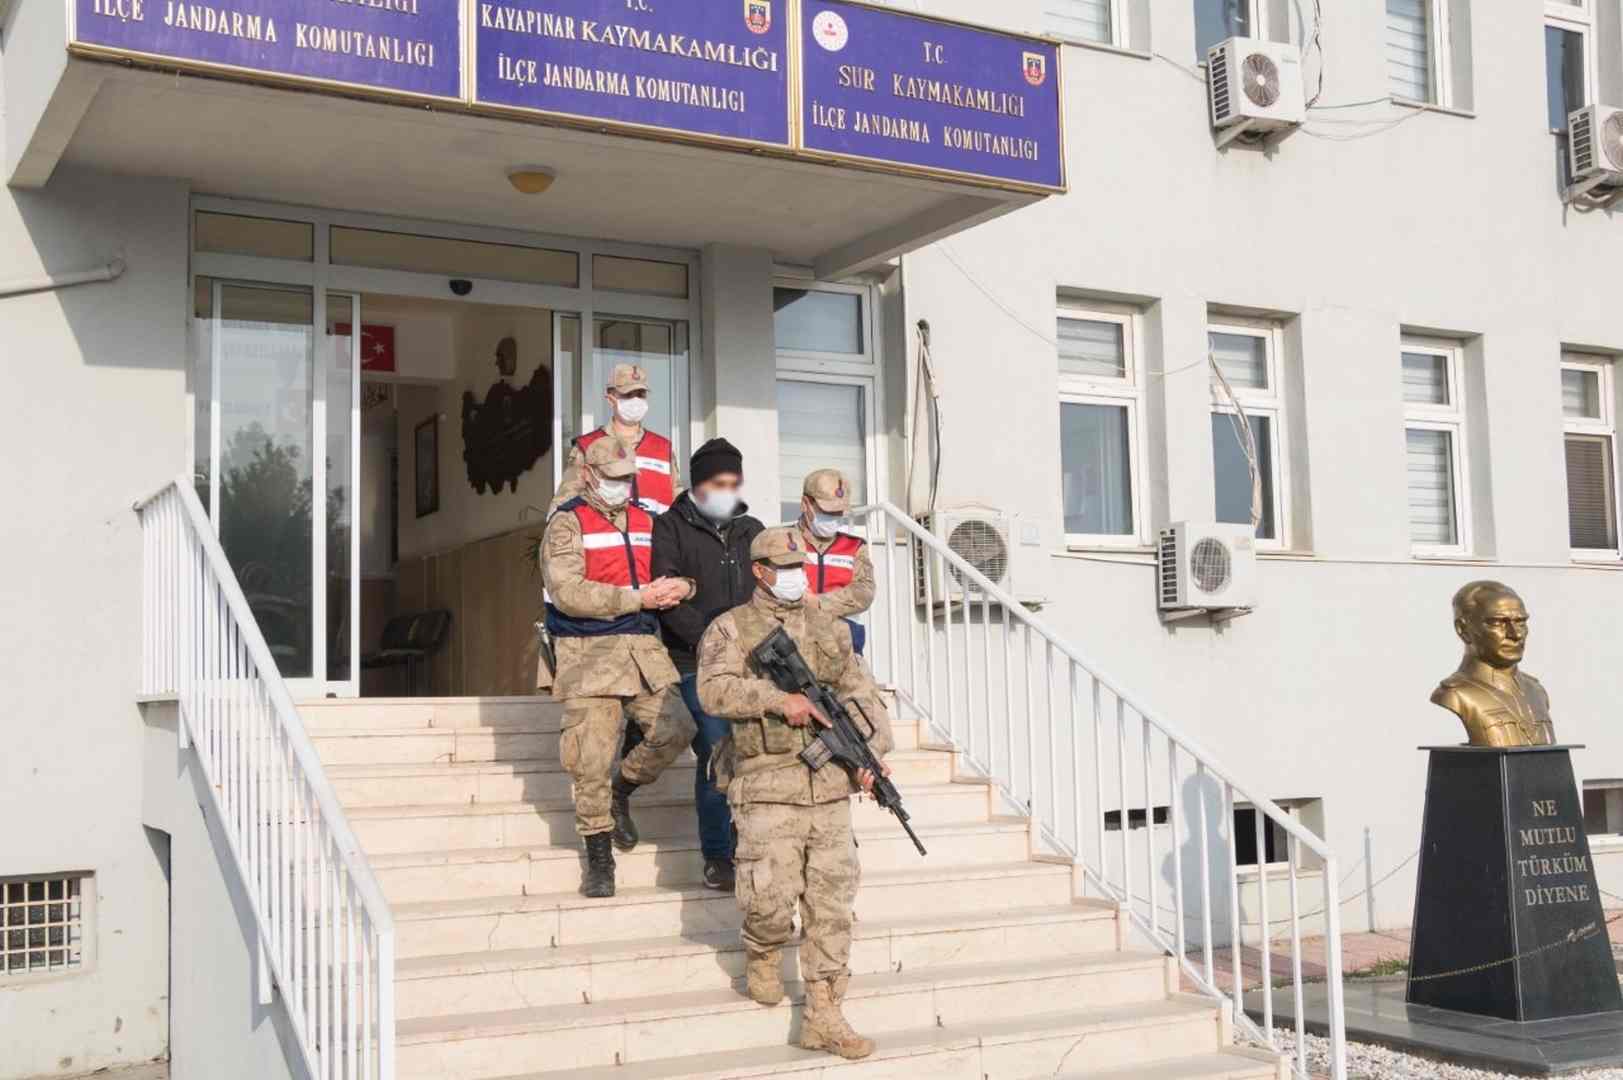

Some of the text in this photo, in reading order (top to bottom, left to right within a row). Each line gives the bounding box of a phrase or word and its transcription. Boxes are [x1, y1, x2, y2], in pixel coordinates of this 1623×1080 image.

[164, 1, 277, 42] JANDARMA
[481, 4, 778, 72] KAYAPINAR KAYMAKAMLIĞI
[498, 53, 537, 87] İLÇE
[543, 63, 630, 96] JANDARMA
[839, 64, 875, 91] SUR
[812, 100, 846, 131] İLÇE
[854, 111, 930, 143] JANDARMA
[1532, 799, 1557, 817] NE
[1519, 827, 1576, 846] MUTLU
[1517, 853, 1588, 877] TÜRKÜM
[1525, 884, 1590, 906] DİYENE
